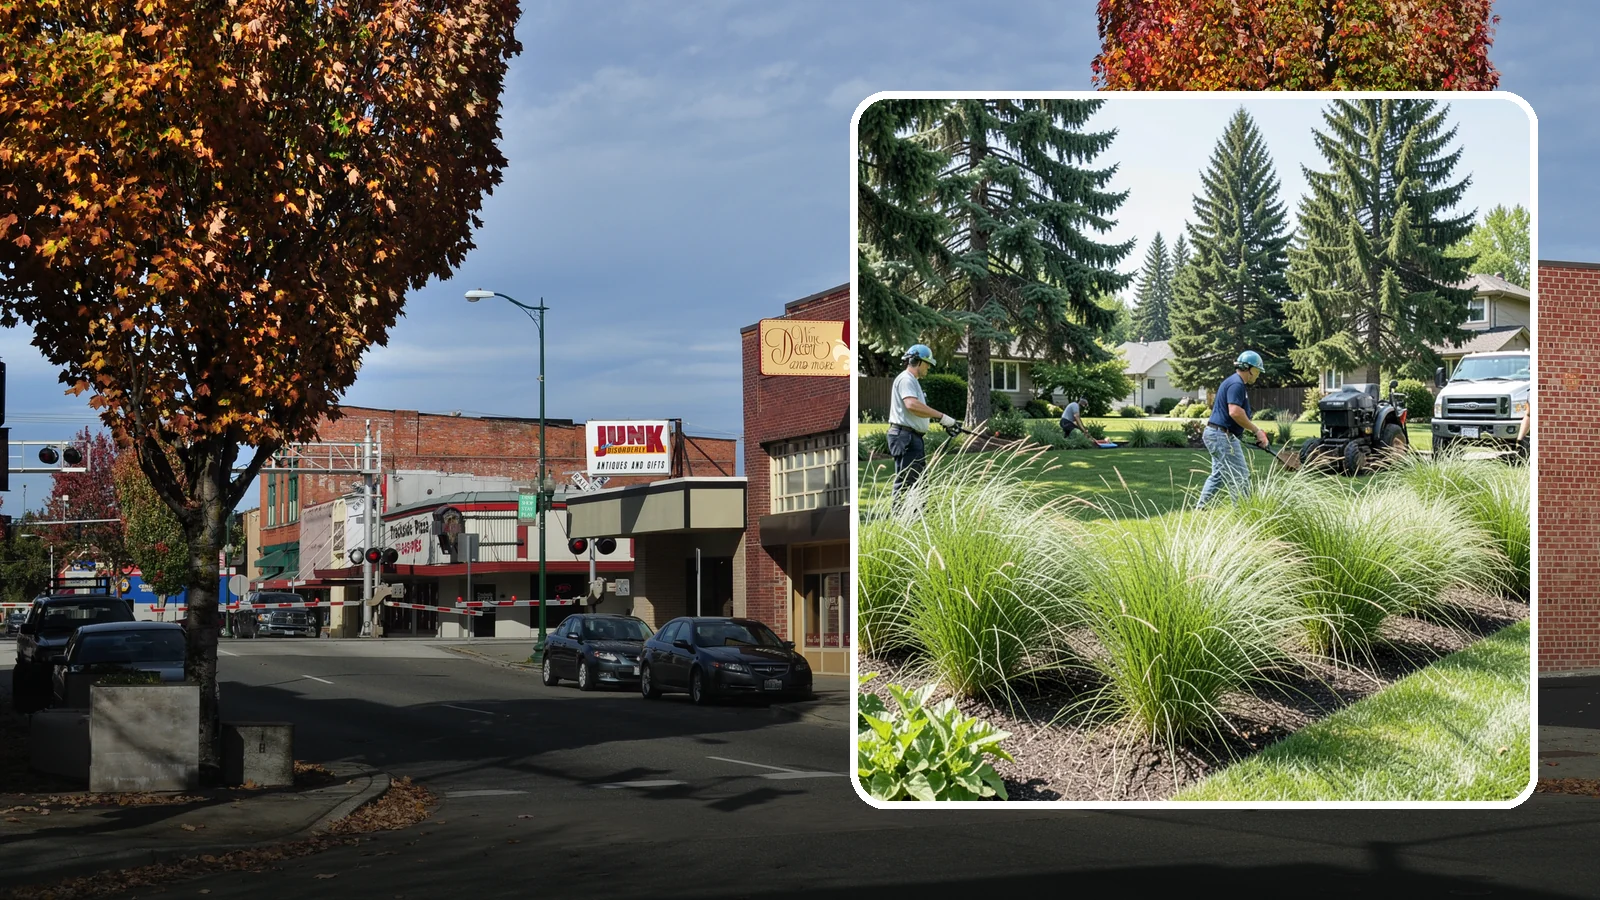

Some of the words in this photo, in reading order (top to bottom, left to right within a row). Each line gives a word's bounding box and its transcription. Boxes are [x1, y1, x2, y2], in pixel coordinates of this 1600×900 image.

[595, 425, 664, 457] JUNK
[607, 446, 645, 454] DISORDERLY
[596, 461, 628, 470] ANTIQUES
[631, 461, 643, 469] AND
[646, 460, 665, 469] GIFTS
[414, 519, 429, 535] Pizza
